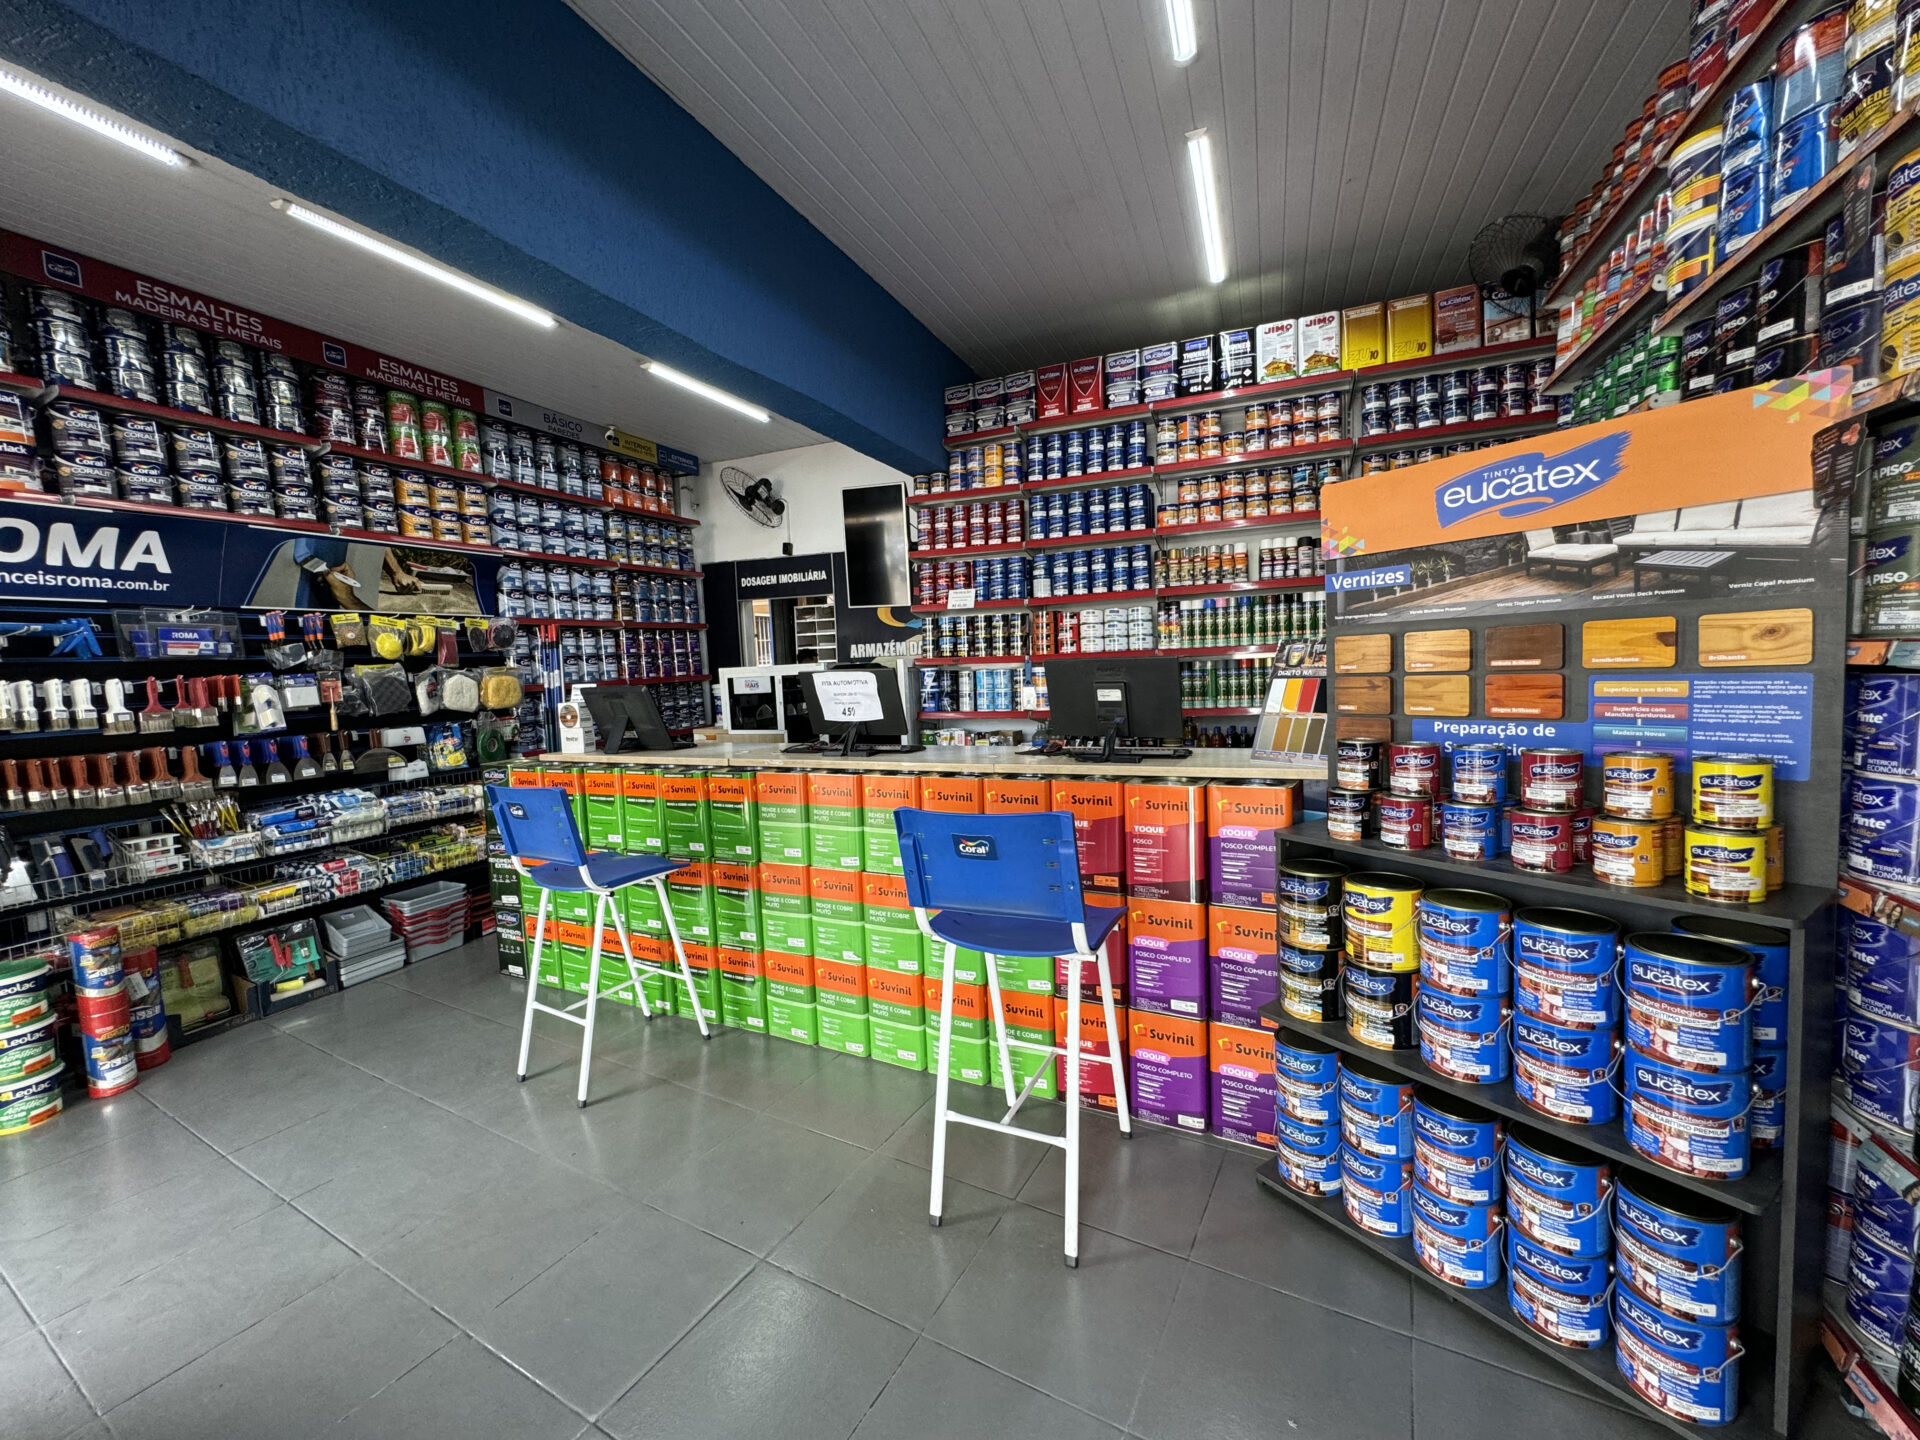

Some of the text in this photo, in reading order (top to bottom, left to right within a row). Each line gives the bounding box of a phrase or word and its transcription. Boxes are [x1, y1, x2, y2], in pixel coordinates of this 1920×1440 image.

[136, 279, 263, 332] ESMALTES
[115, 290, 283, 350] MADEIRAS E METAIS
[1305, 315, 1335, 327] JIMO
[1723, 316, 1747, 331] PISO
[1264, 324, 1293, 335] JIMO
[1687, 347, 1708, 360] PISO
[378, 358, 458, 393] ESMALTES
[366, 367, 471, 407] MADEIRAS E METAIS
[543, 412, 583, 433] BÁSICO
[1483, 465, 1525, 479] TINTAS
[1879, 462, 1913, 476] PISO
[1444, 459, 1599, 508] eucatex
[741, 569, 827, 587] DOSAGEM IMOBILIÁRIA
[1332, 569, 1404, 590] Vernizes
[1754, 580, 1776, 588] Copal
[1778, 576, 1815, 585] Premium
[1873, 572, 1908, 584] PISO
[850, 640, 906, 658] ARMAZÉM
[1434, 722, 1555, 737] Preparação de
[1396, 756, 1431, 765] eucatex
[1867, 758, 1898, 767] INTERIOR
[1532, 766, 1576, 775] eucatex
[1605, 769, 1649, 780] eucatex
[1867, 764, 1919, 775] ECONÔMICA
[518, 778, 537, 786] Suvinil
[551, 779, 573, 788] Suvinil
[593, 780, 615, 789] Suvinil
[632, 781, 655, 791] Suvinil
[1701, 776, 1756, 787] eucatex
[671, 784, 696, 794] Suvinil
[718, 785, 744, 795] Suvinil
[769, 785, 797, 794] Suvinil
[821, 787, 852, 797] Suvinil
[876, 789, 909, 800] Suvinil
[937, 791, 973, 803] Suvinil
[1001, 793, 1038, 805] Suvinil
[1071, 794, 1113, 807] Suvinil
[1145, 800, 1189, 812] Suvinil
[1235, 803, 1284, 815] Suvinil
[1445, 813, 1483, 823] eucatex
[1134, 825, 1164, 834] TOQUE
[1221, 829, 1253, 838] TOQUE
[1513, 826, 1554, 836] eucatex
[959, 844, 985, 854] Coral
[1244, 844, 1276, 852] COMPLET
[1691, 848, 1747, 860] eucatex
[723, 870, 749, 882] Suvinil
[824, 881, 853, 892] Suvinil
[1147, 915, 1193, 930] Suvinil
[1422, 912, 1470, 934] eucatex
[638, 943, 661, 955] Suvinil
[1135, 937, 1165, 948] TOQUE
[1522, 936, 1589, 959] eucatex
[728, 956, 755, 969] Suvinil
[1135, 951, 1191, 963] FOSCO COMPLETO
[778, 963, 804, 976] Suvinil
[1522, 962, 1587, 982] Sempre Protegido
[828, 972, 857, 986] Suvinil
[1632, 964, 1710, 993] eucatex
[881, 982, 912, 997] Suvinil
[1422, 993, 1473, 1019] eucatex
[1632, 991, 1708, 1019] Sempre Protegido
[1861, 1002, 1913, 1024] ECONÔMICA
[4, 1029, 46, 1047] Leolac
[1150, 1029, 1195, 1047] Suvinil
[1519, 1025, 1581, 1054] eucatex
[1138, 1052, 1167, 1062] TOQUE
[1137, 1063, 1193, 1080] FOSCO COMPLETO
[1542, 1061, 1580, 1077] Protegido
[11, 1080, 51, 1098] Leolac
[1638, 1070, 1722, 1102] eucatex
[1639, 1096, 1718, 1127] Sempre Protegido
[1693, 1124, 1728, 1137] PREMIUM
[1619, 1199, 1688, 1246] eucatex
[1642, 1242, 1685, 1269] Protegido
[1517, 1244, 1583, 1282] eucatex
[1543, 1287, 1581, 1304] Protegido
[1619, 1296, 1690, 1349] eucatex
